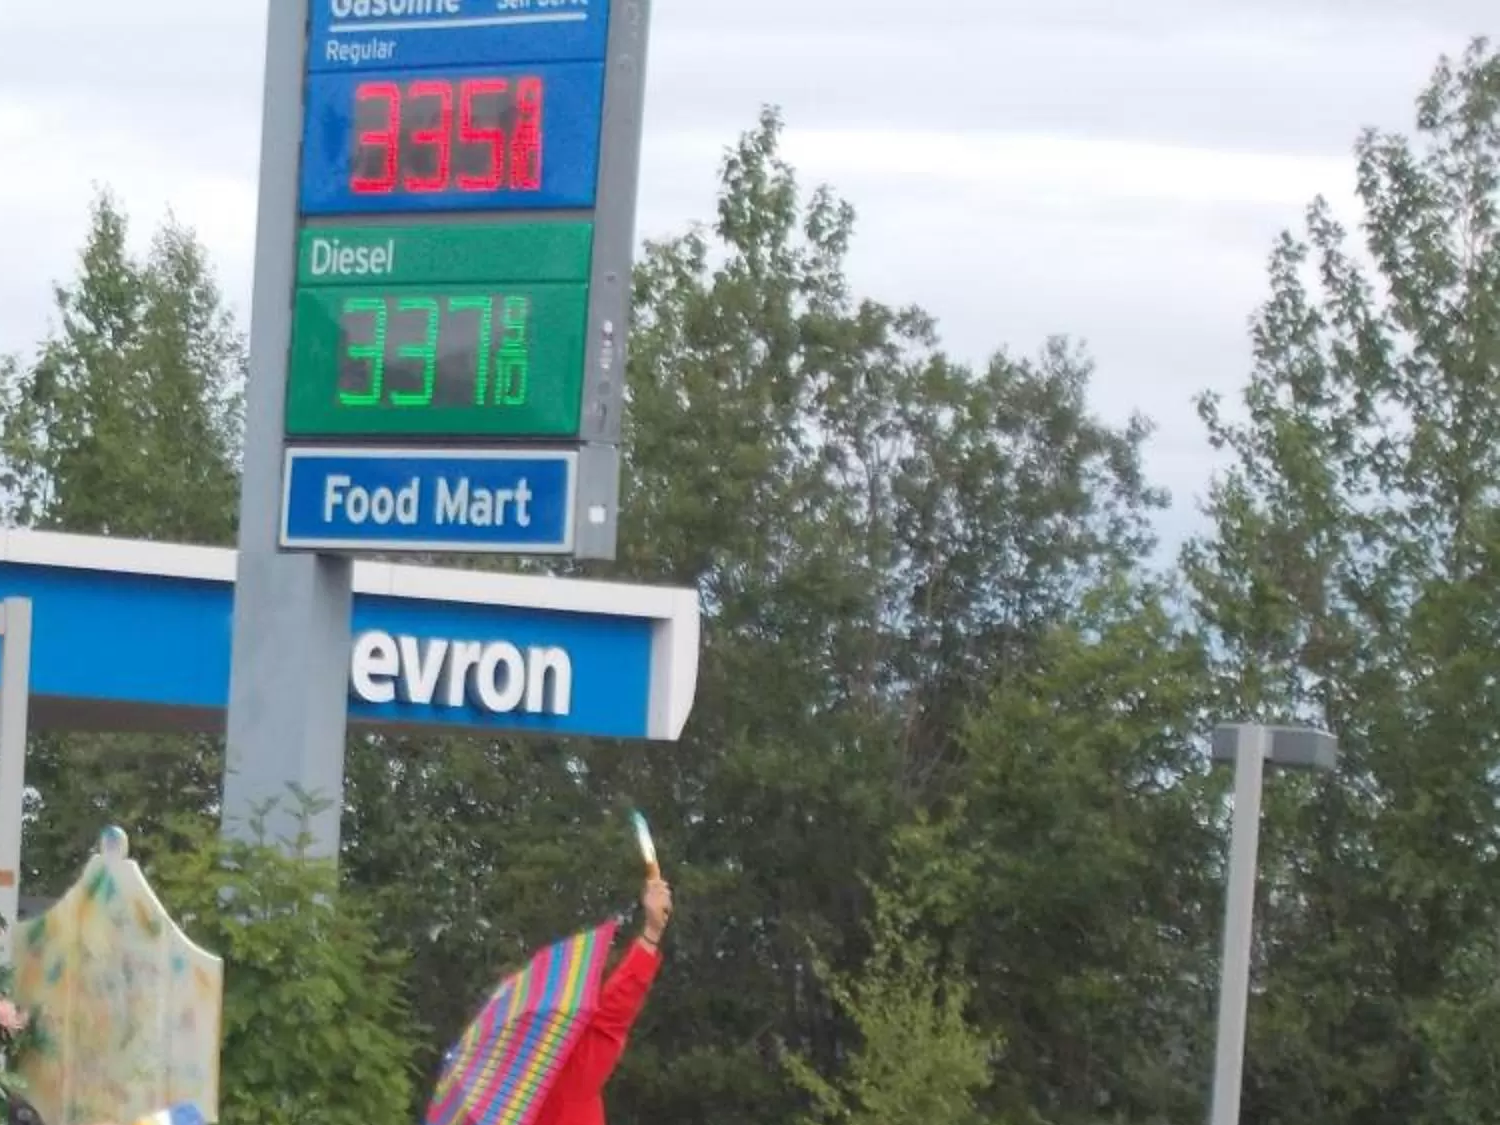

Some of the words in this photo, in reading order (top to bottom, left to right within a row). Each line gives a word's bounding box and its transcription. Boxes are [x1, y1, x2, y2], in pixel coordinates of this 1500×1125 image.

[326, 38, 396, 64] Regular
[311, 239, 393, 275] Diesel
[325, 475, 420, 525] Food
[435, 476, 532, 527] Mart
[352, 629, 572, 716] evron
